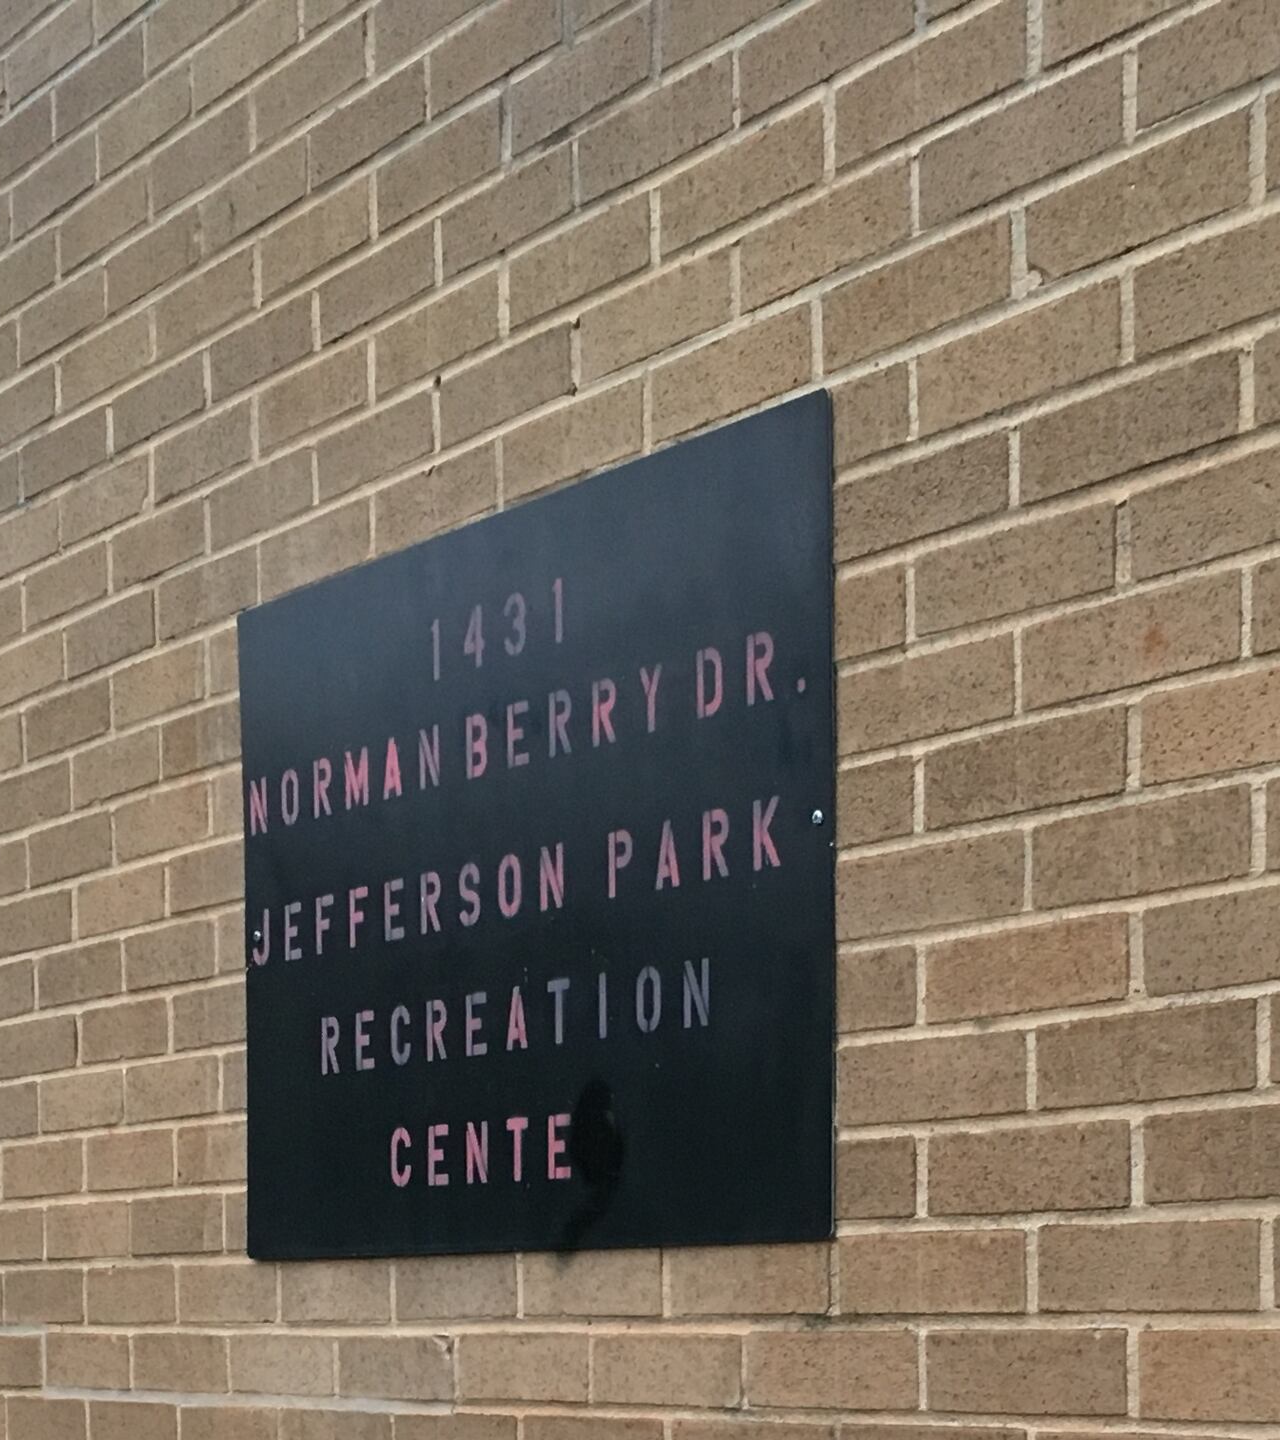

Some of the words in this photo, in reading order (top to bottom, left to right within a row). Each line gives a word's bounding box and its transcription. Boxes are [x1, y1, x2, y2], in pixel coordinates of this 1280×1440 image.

[431, 578, 565, 680] 1431
[250, 724, 440, 836] NORMAN
[465, 665, 663, 781] BERRY
[695, 630, 807, 721] DR.
[252, 842, 564, 966] JEFFERSON
[607, 795, 781, 899] PARK
[320, 958, 711, 1076] RECREATION
